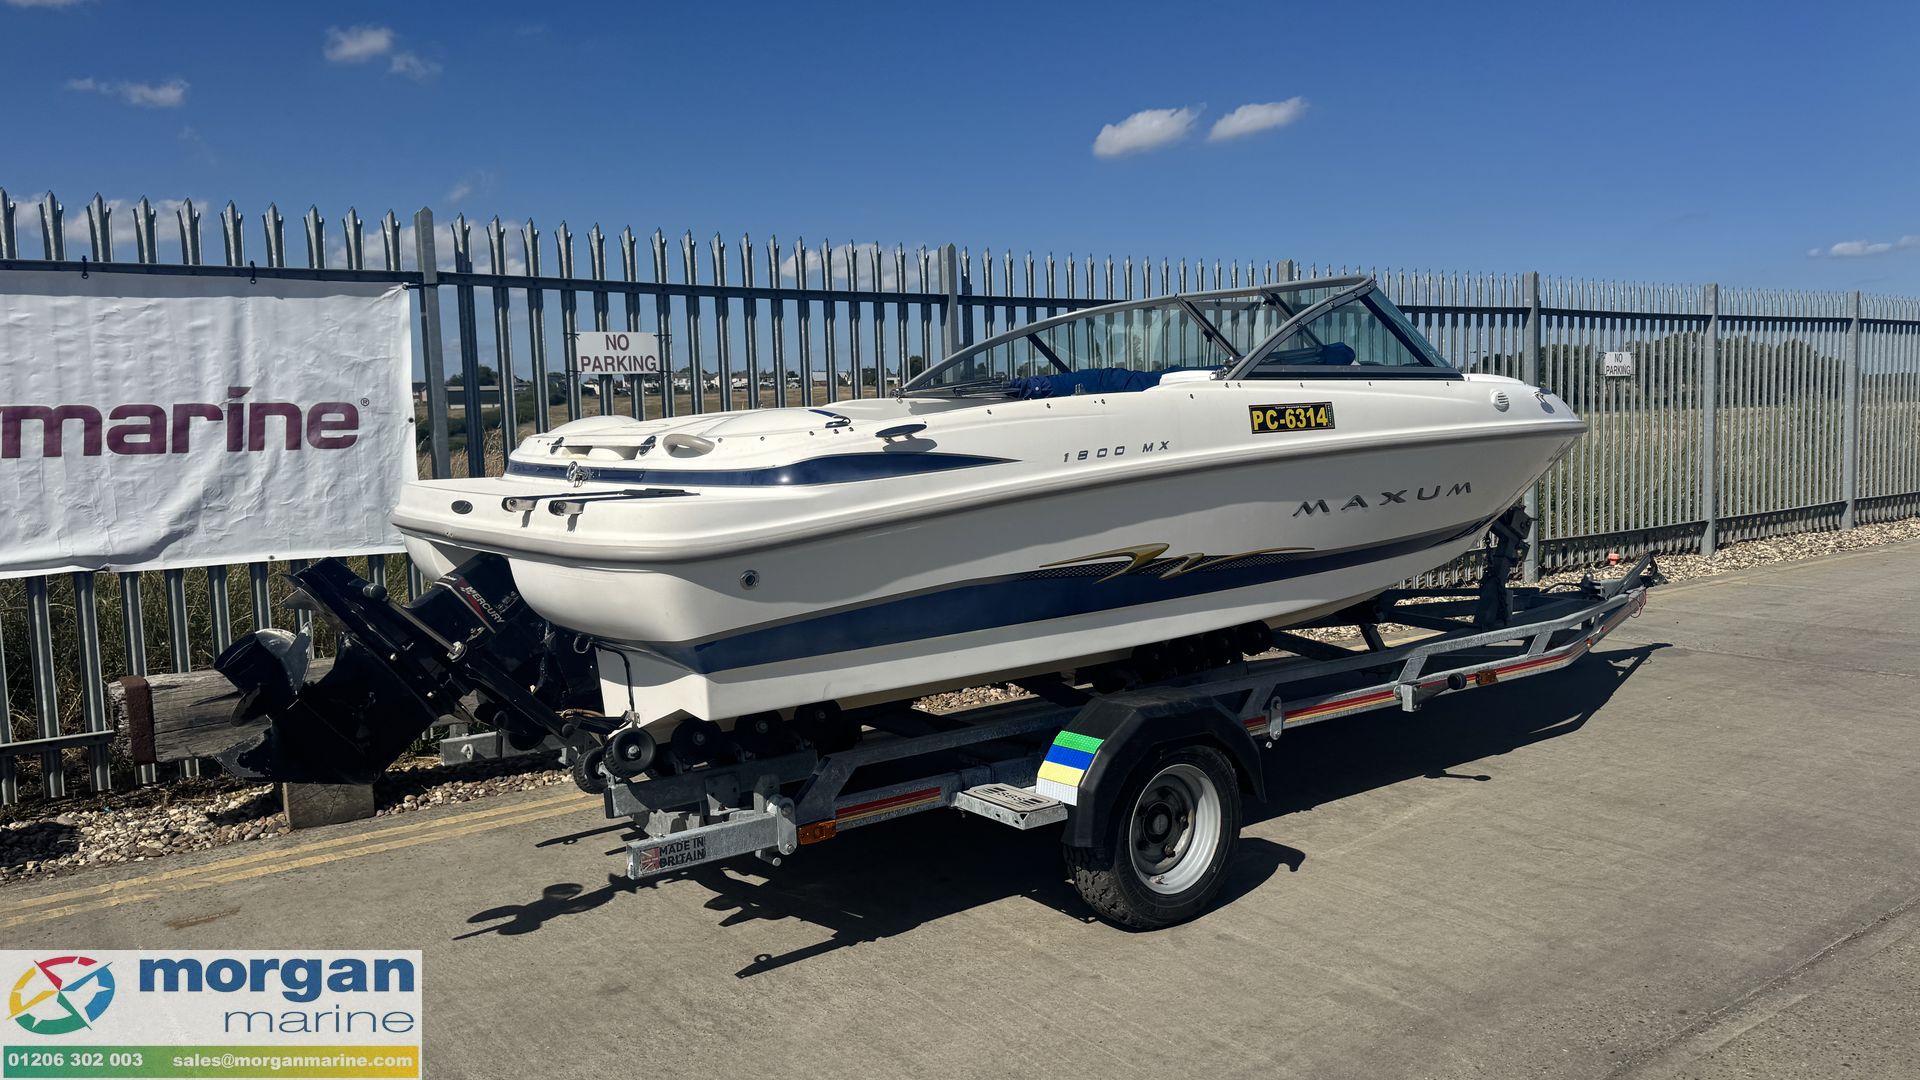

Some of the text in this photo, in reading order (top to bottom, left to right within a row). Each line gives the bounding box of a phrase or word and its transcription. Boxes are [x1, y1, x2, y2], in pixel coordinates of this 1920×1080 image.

[605, 334, 630, 351] NO
[580, 355, 657, 372] PARKING
[1614, 353, 1624, 363] NO
[1605, 365, 1631, 375] PARKING
[1252, 407, 1329, 431] PC-6314
[1063, 441, 1169, 463] 1800 MX
[1292, 482, 1472, 517] MAXUM
[466, 586, 505, 624] MERCURY
[660, 836, 706, 857] MADE IN
[660, 848, 706, 868] BRITAIN
